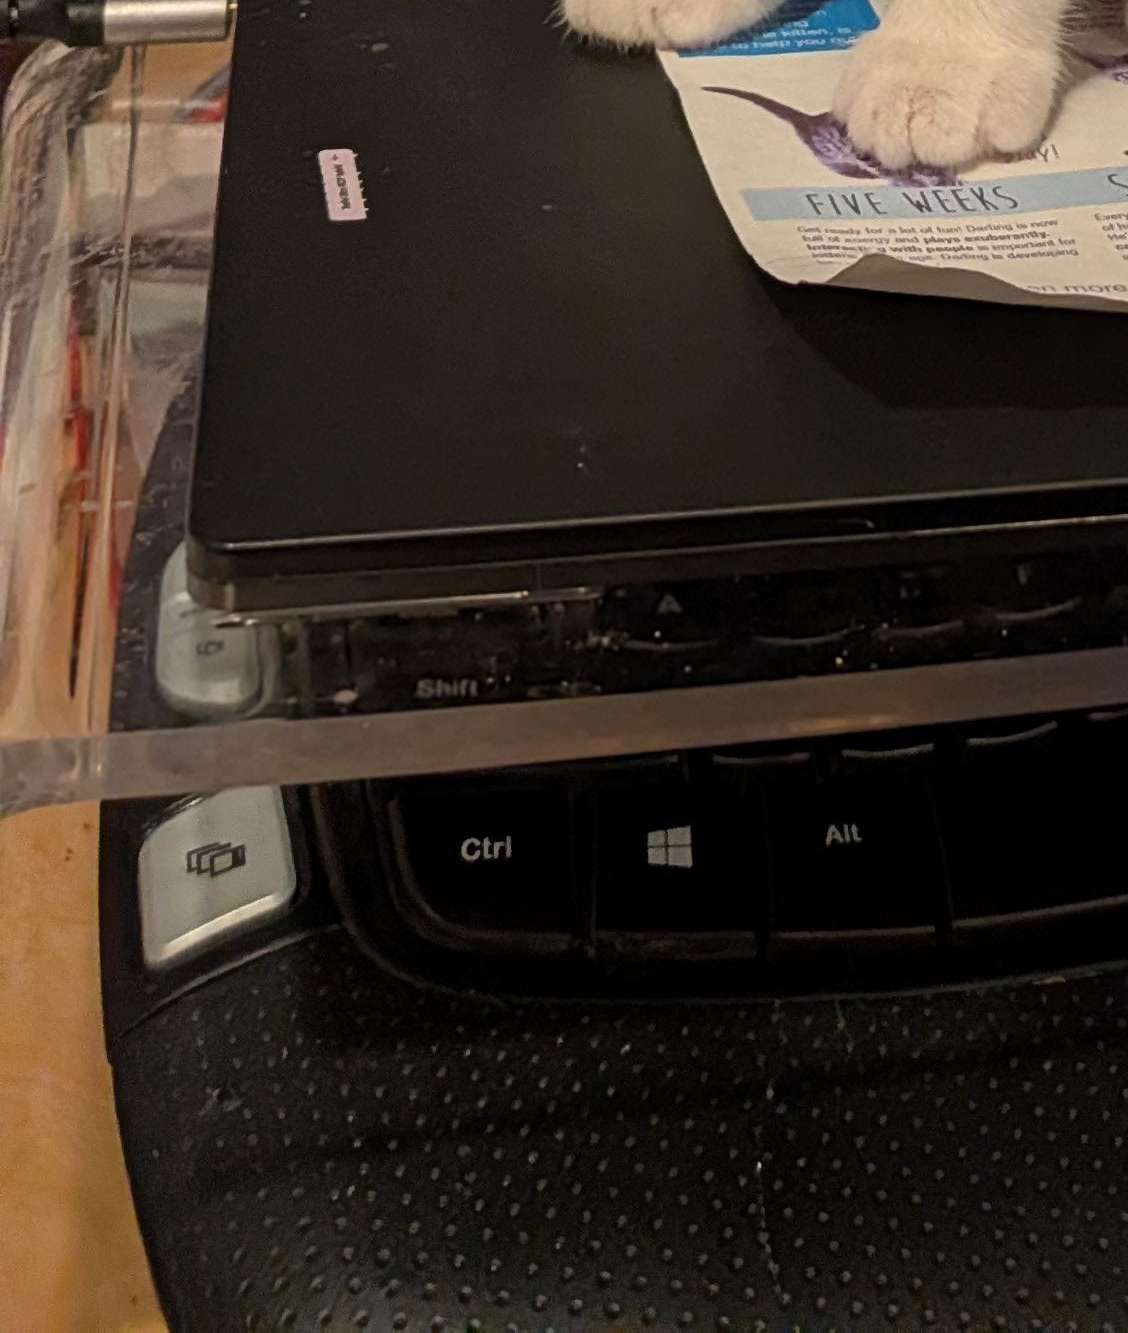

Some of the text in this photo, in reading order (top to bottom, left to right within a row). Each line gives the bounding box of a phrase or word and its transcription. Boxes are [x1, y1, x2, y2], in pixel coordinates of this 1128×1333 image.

[805, 185, 1019, 216] FIVE WEEKS
[923, 234, 961, 246] plays
[1007, 248, 1080, 262] developing
[1064, 282, 1128, 294] more
[415, 677, 480, 700] Shift
[825, 823, 863, 848] Alt
[460, 835, 512, 862] Ctrl
